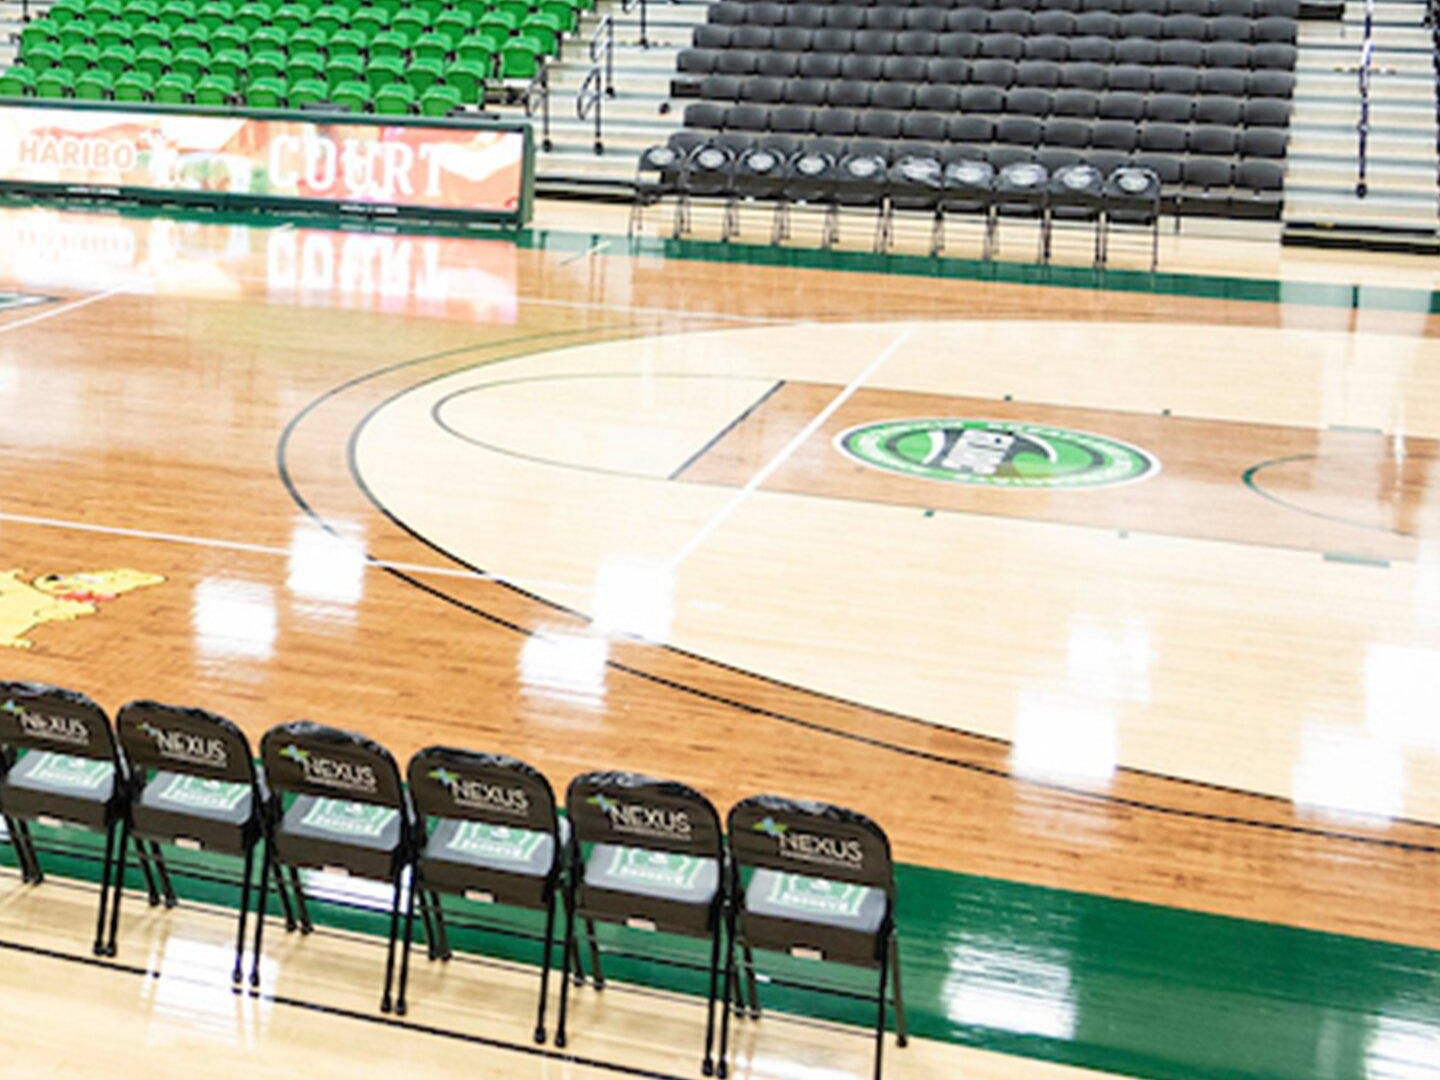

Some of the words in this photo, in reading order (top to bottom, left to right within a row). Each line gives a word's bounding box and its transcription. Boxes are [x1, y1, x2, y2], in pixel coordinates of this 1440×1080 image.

[19, 133, 135, 173] HARIBO
[268, 132, 444, 197] COURT
[157, 730, 226, 761] NEXUS
[303, 756, 376, 788] NEXUS
[453, 779, 529, 809] NEXUS
[611, 805, 691, 833] NEXUS
[778, 832, 864, 863] NEXUS
